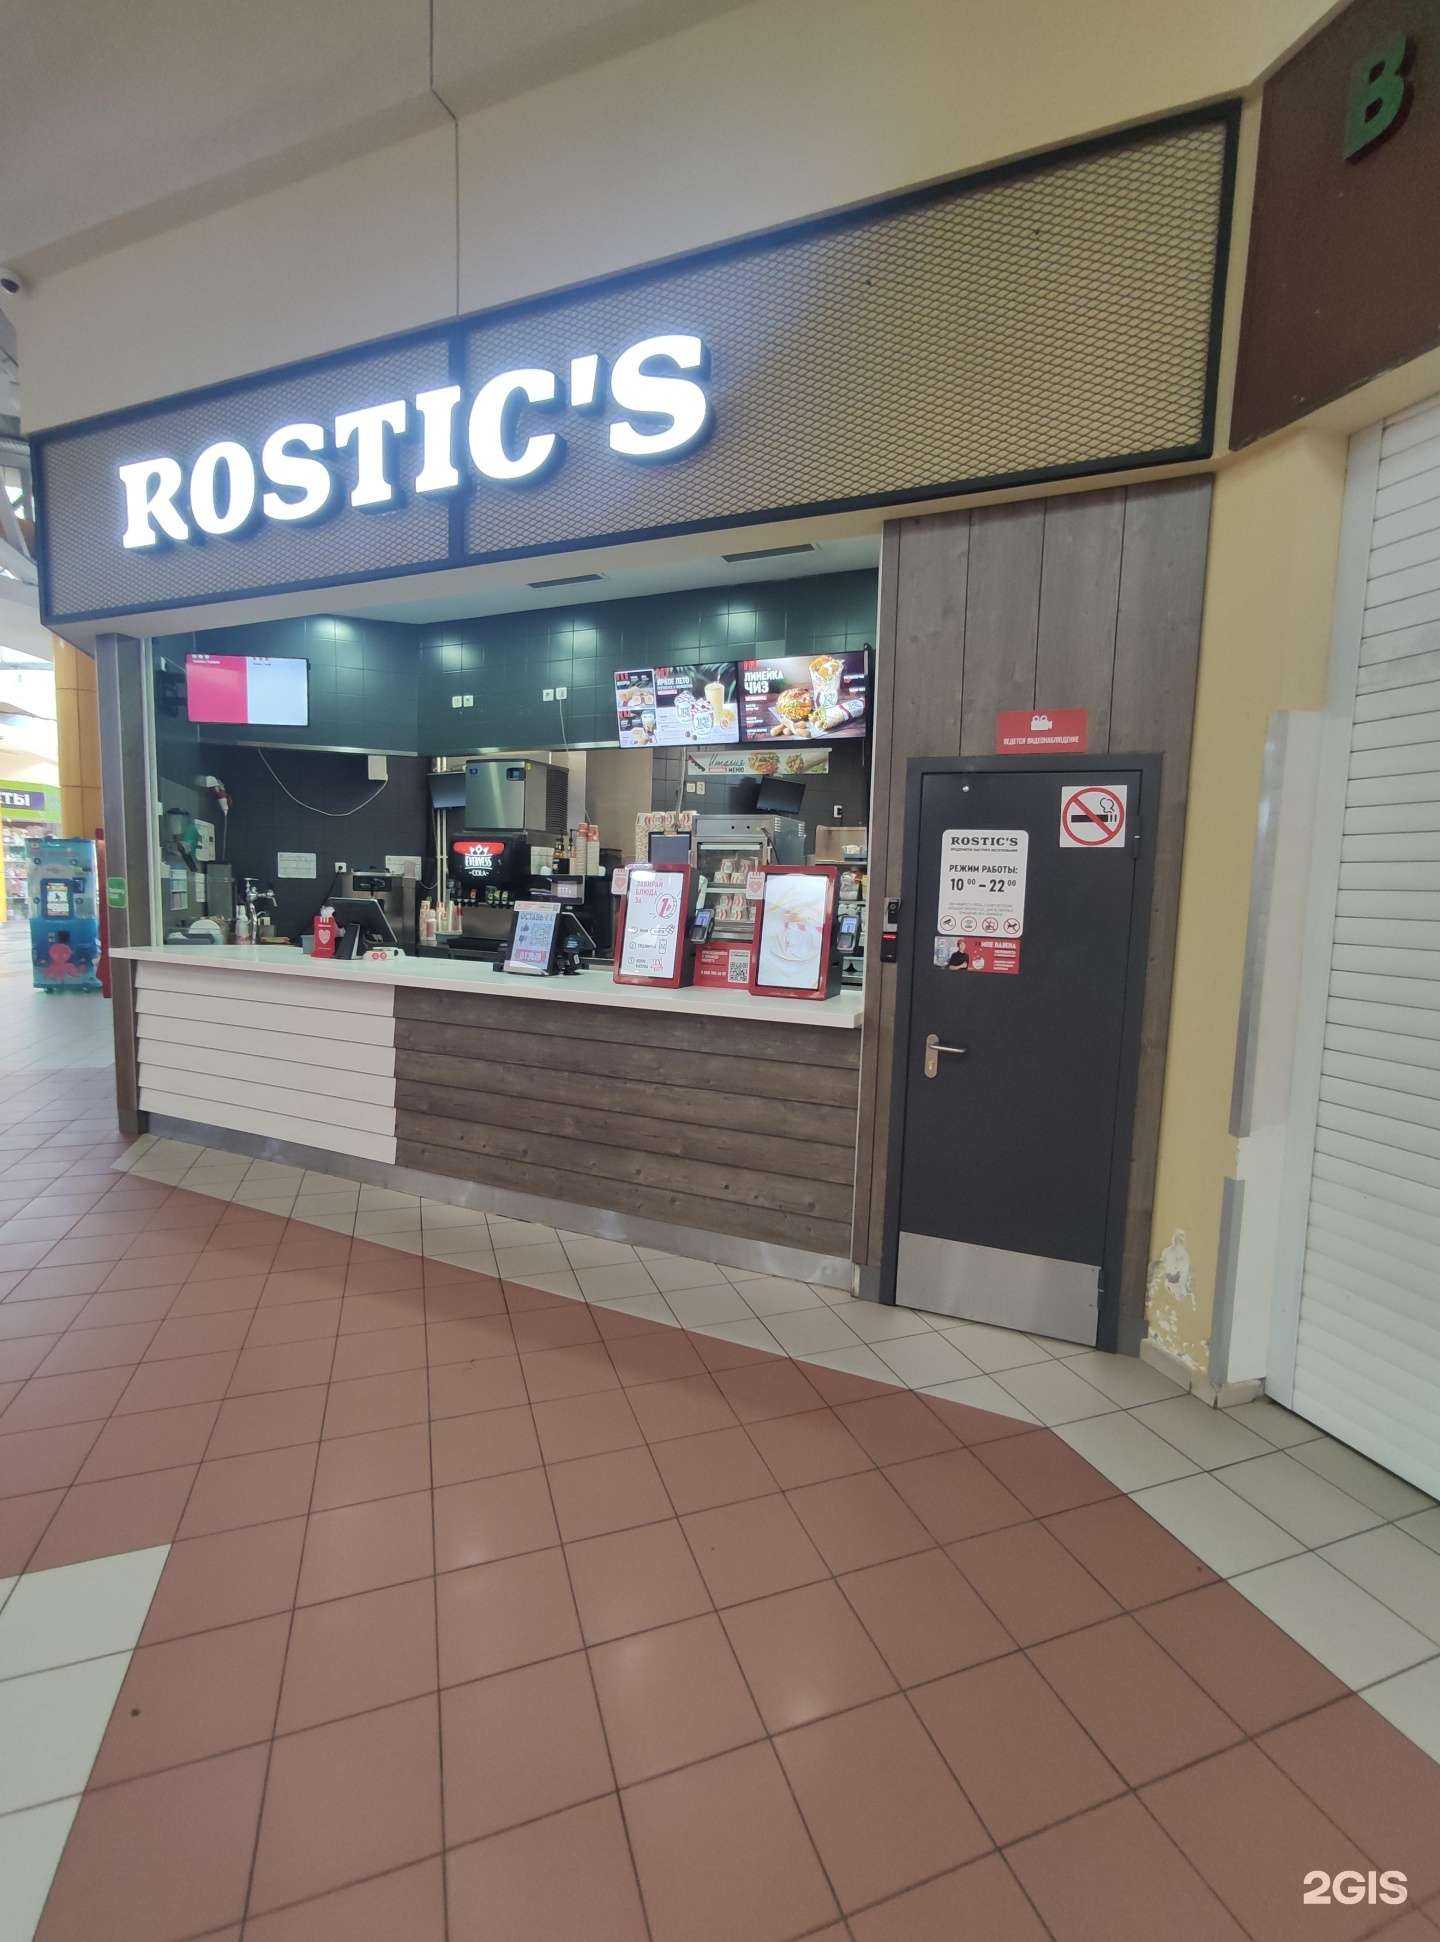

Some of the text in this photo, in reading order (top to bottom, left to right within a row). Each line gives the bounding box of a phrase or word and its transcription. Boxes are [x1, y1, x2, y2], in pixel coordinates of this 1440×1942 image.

[118, 334, 708, 550] ROSTIC'S
[744, 668, 784, 682] ЛИНЕЙКА
[744, 681, 769, 694] ЧИЗ
[728, 766, 745, 774] МЕНЮ
[0, 790, 31, 807] ТЫ
[950, 836, 1019, 847] ROSTIC'S
[949, 864, 1019, 875] РЕЖИМ РАБОТЫ:
[950, 878, 965, 892] 10
[989, 879, 1005, 893] 22
